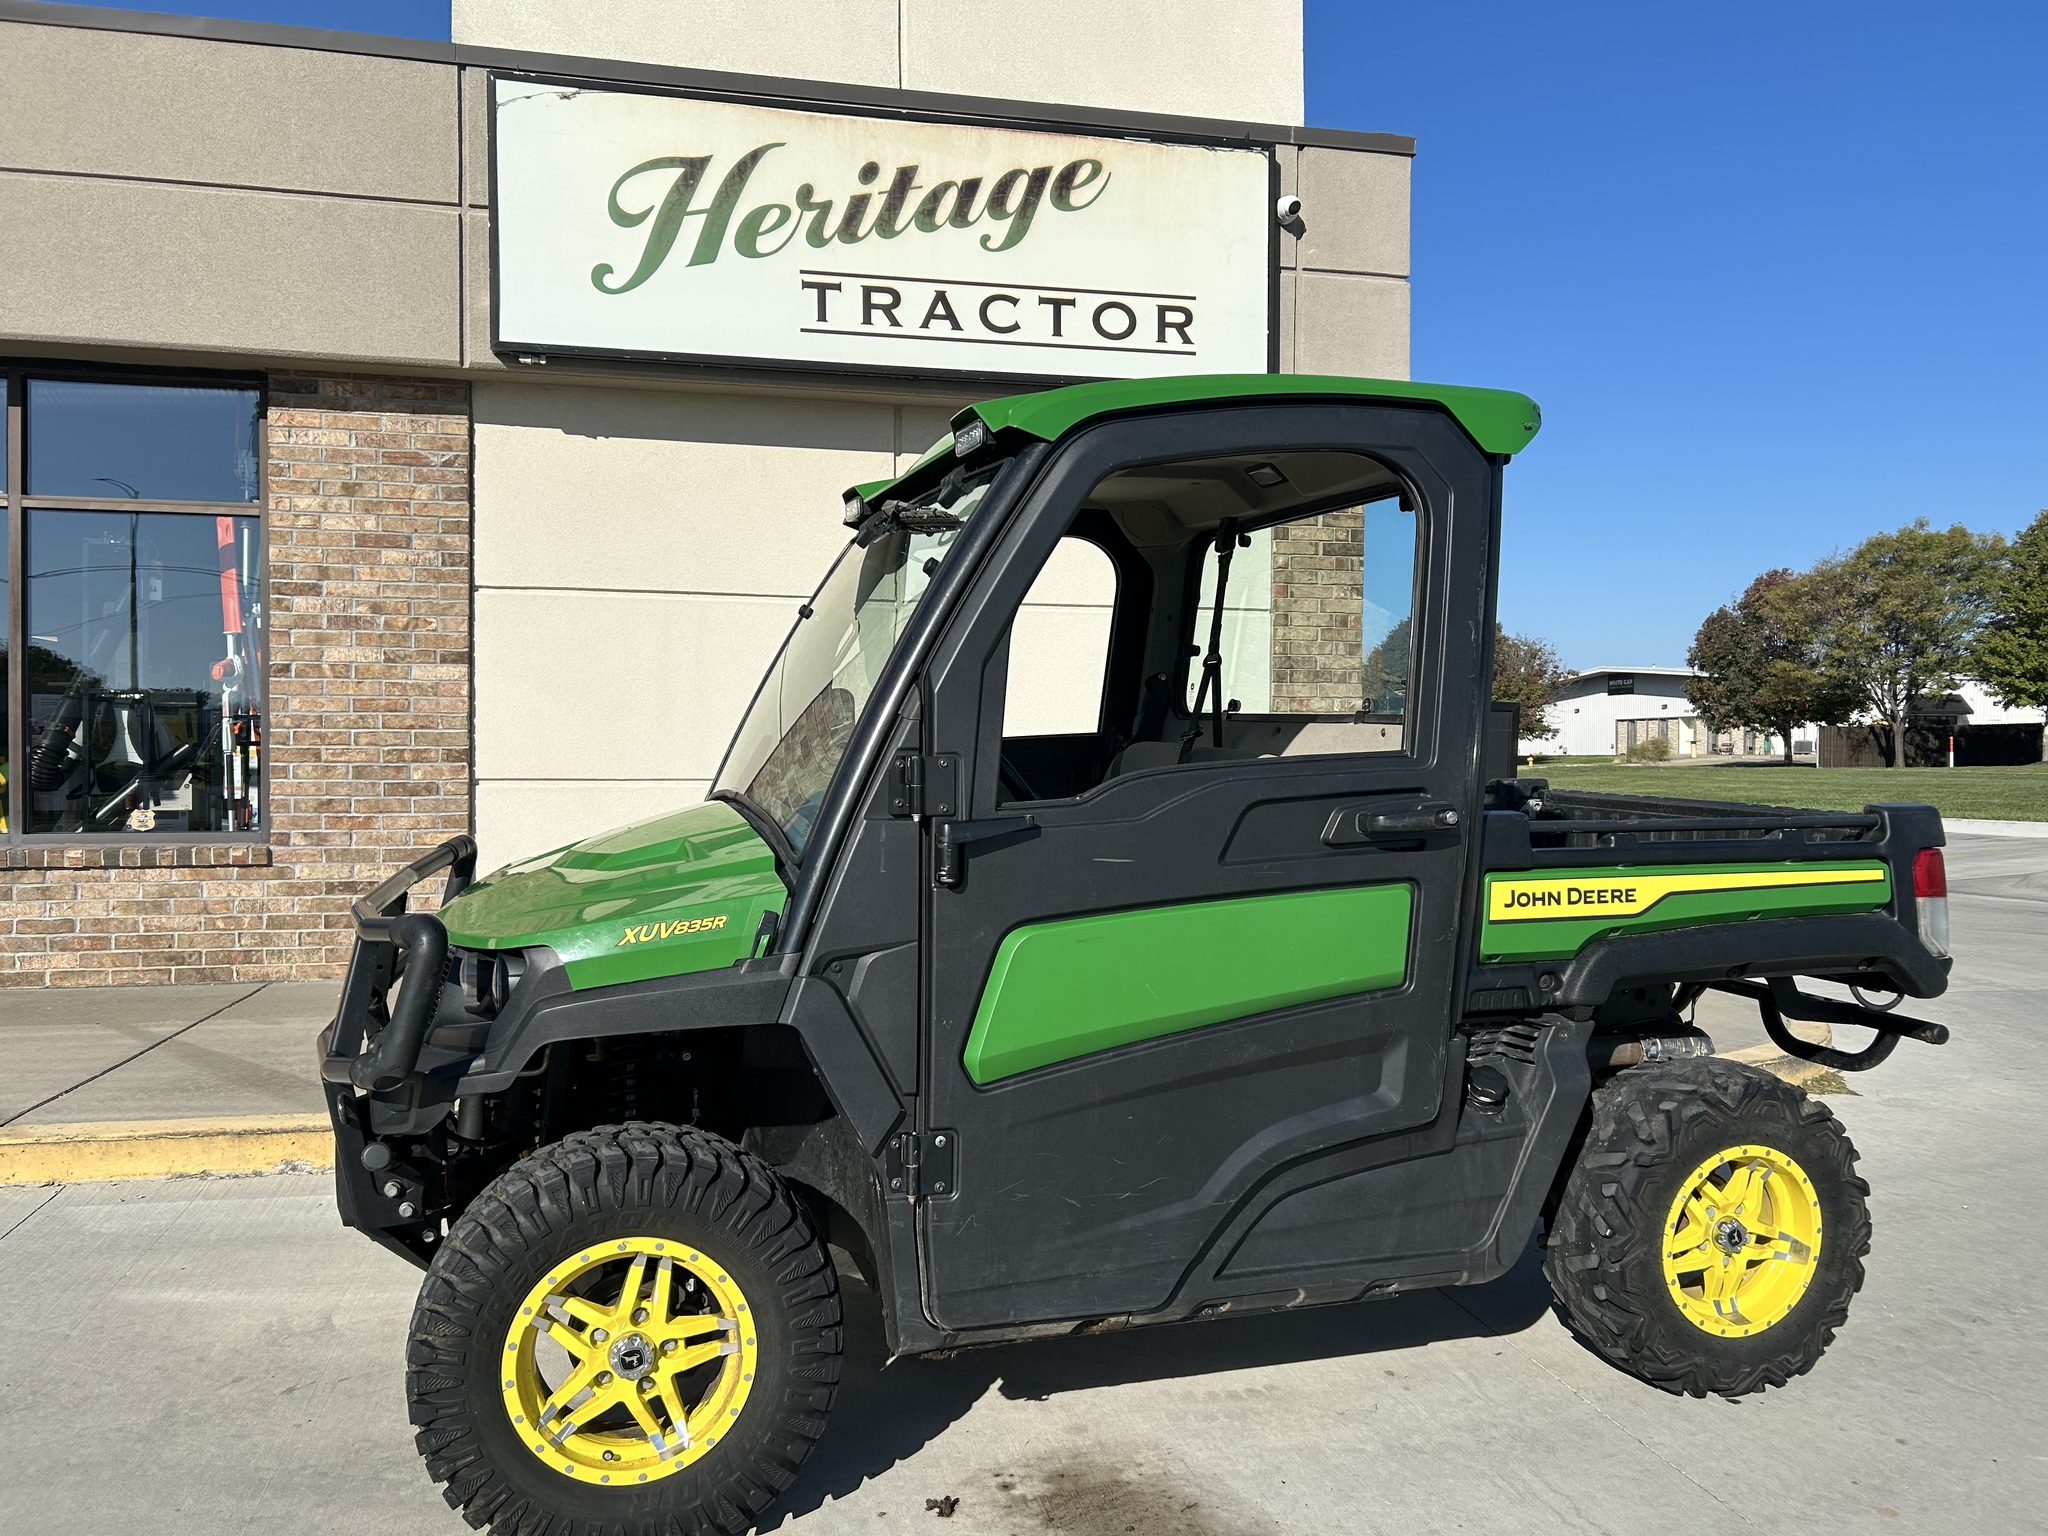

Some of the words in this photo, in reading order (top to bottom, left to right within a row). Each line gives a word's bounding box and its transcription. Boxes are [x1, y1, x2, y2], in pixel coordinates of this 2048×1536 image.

[589, 141, 1112, 295] Heritage
[801, 279, 1196, 346] TRACTOR
[616, 915, 729, 946] XUV835R
[1504, 889, 1561, 908] JOHN
[1567, 887, 1637, 905] DEERE
[474, 1209, 677, 1352] PREDATOR
